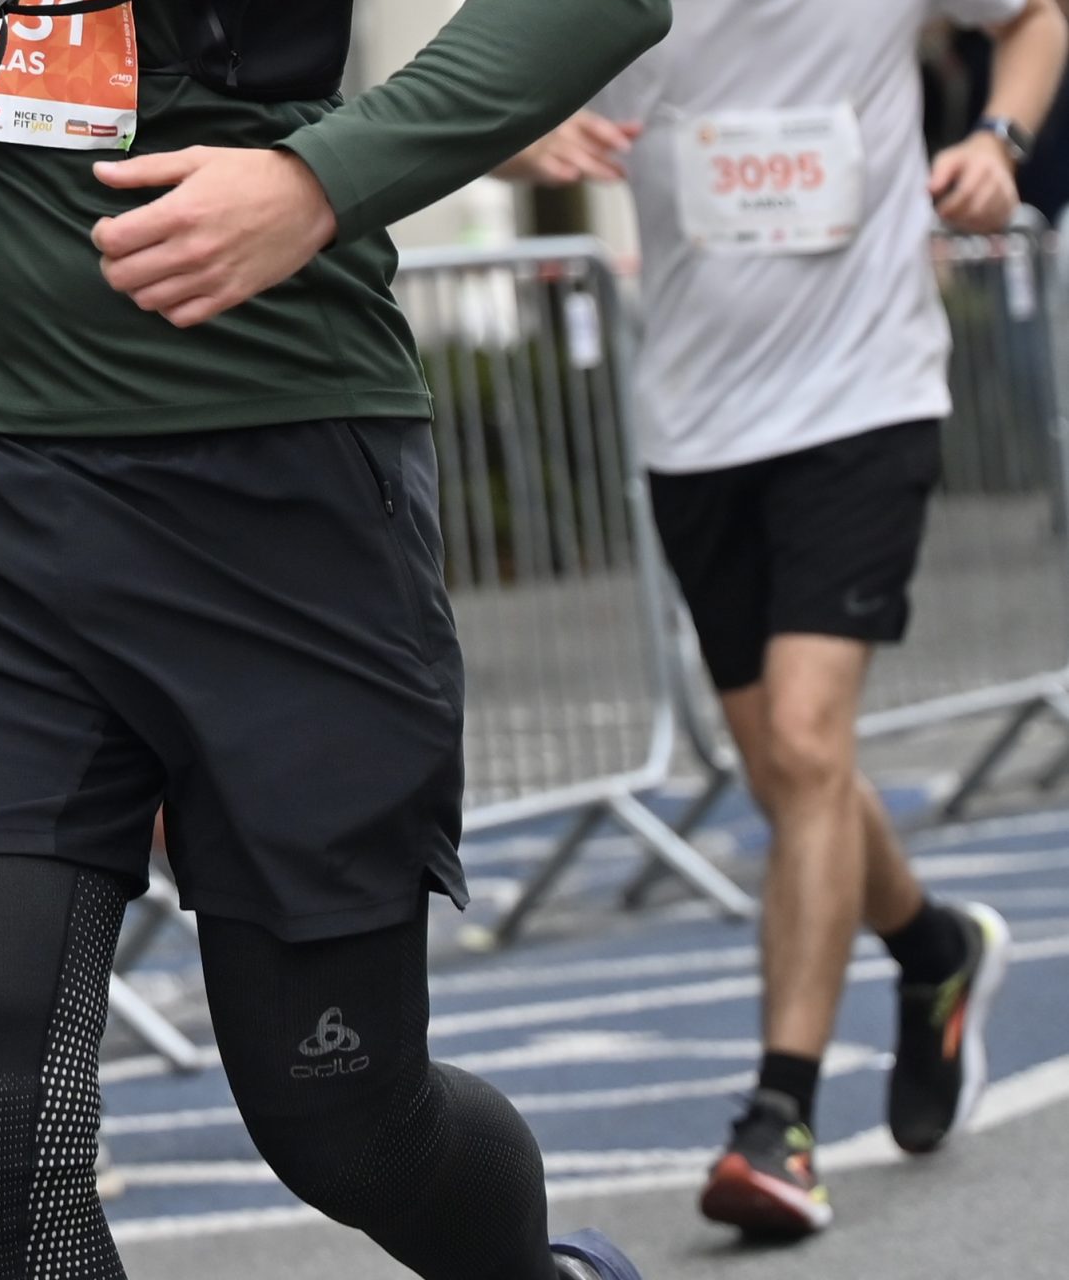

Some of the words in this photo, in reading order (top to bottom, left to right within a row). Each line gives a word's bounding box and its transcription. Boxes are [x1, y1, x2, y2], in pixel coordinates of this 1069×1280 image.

[14, 110, 37, 121] NICE
[41, 114, 53, 123] TO
[14, 119, 30, 129] FIT
[31, 121, 52, 133] you
[711, 150, 825, 195] 3095
